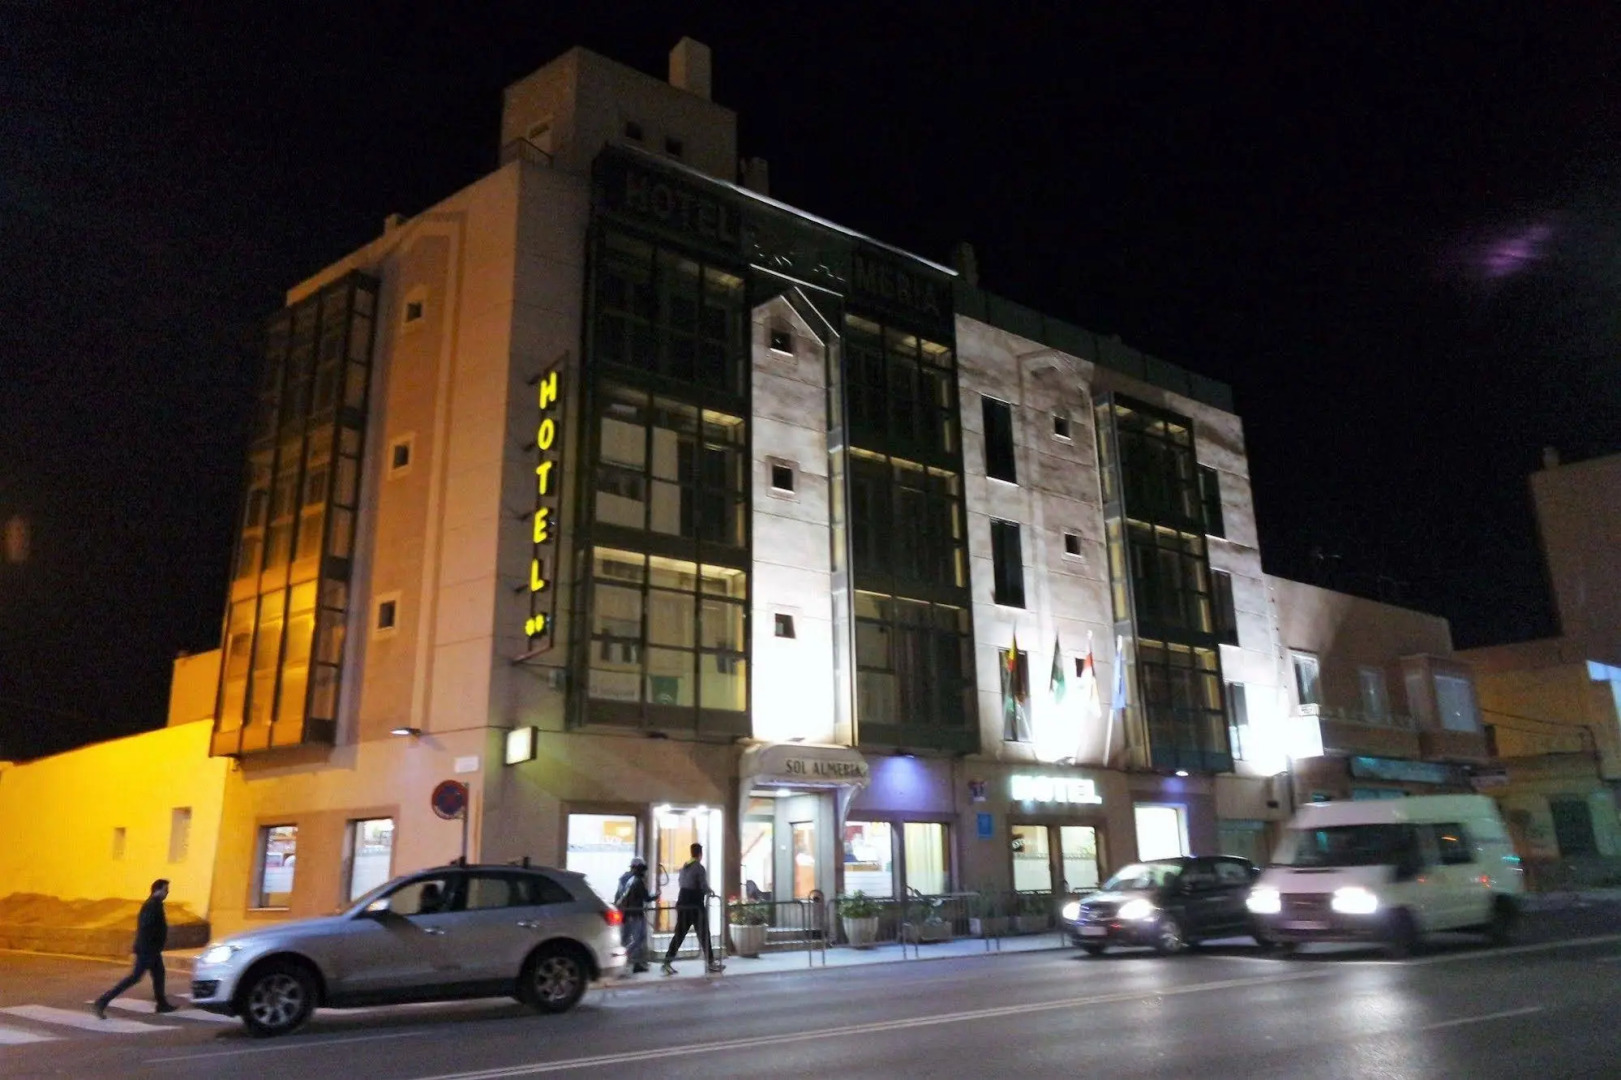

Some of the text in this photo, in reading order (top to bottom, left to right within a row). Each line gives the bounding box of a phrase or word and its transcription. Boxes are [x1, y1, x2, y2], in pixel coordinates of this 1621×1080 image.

[626, 170, 737, 243] HOTEL
[530, 371, 557, 592] HOTEL
[785, 759, 807, 775] SOL
[1011, 775, 1102, 804] HOTEL
